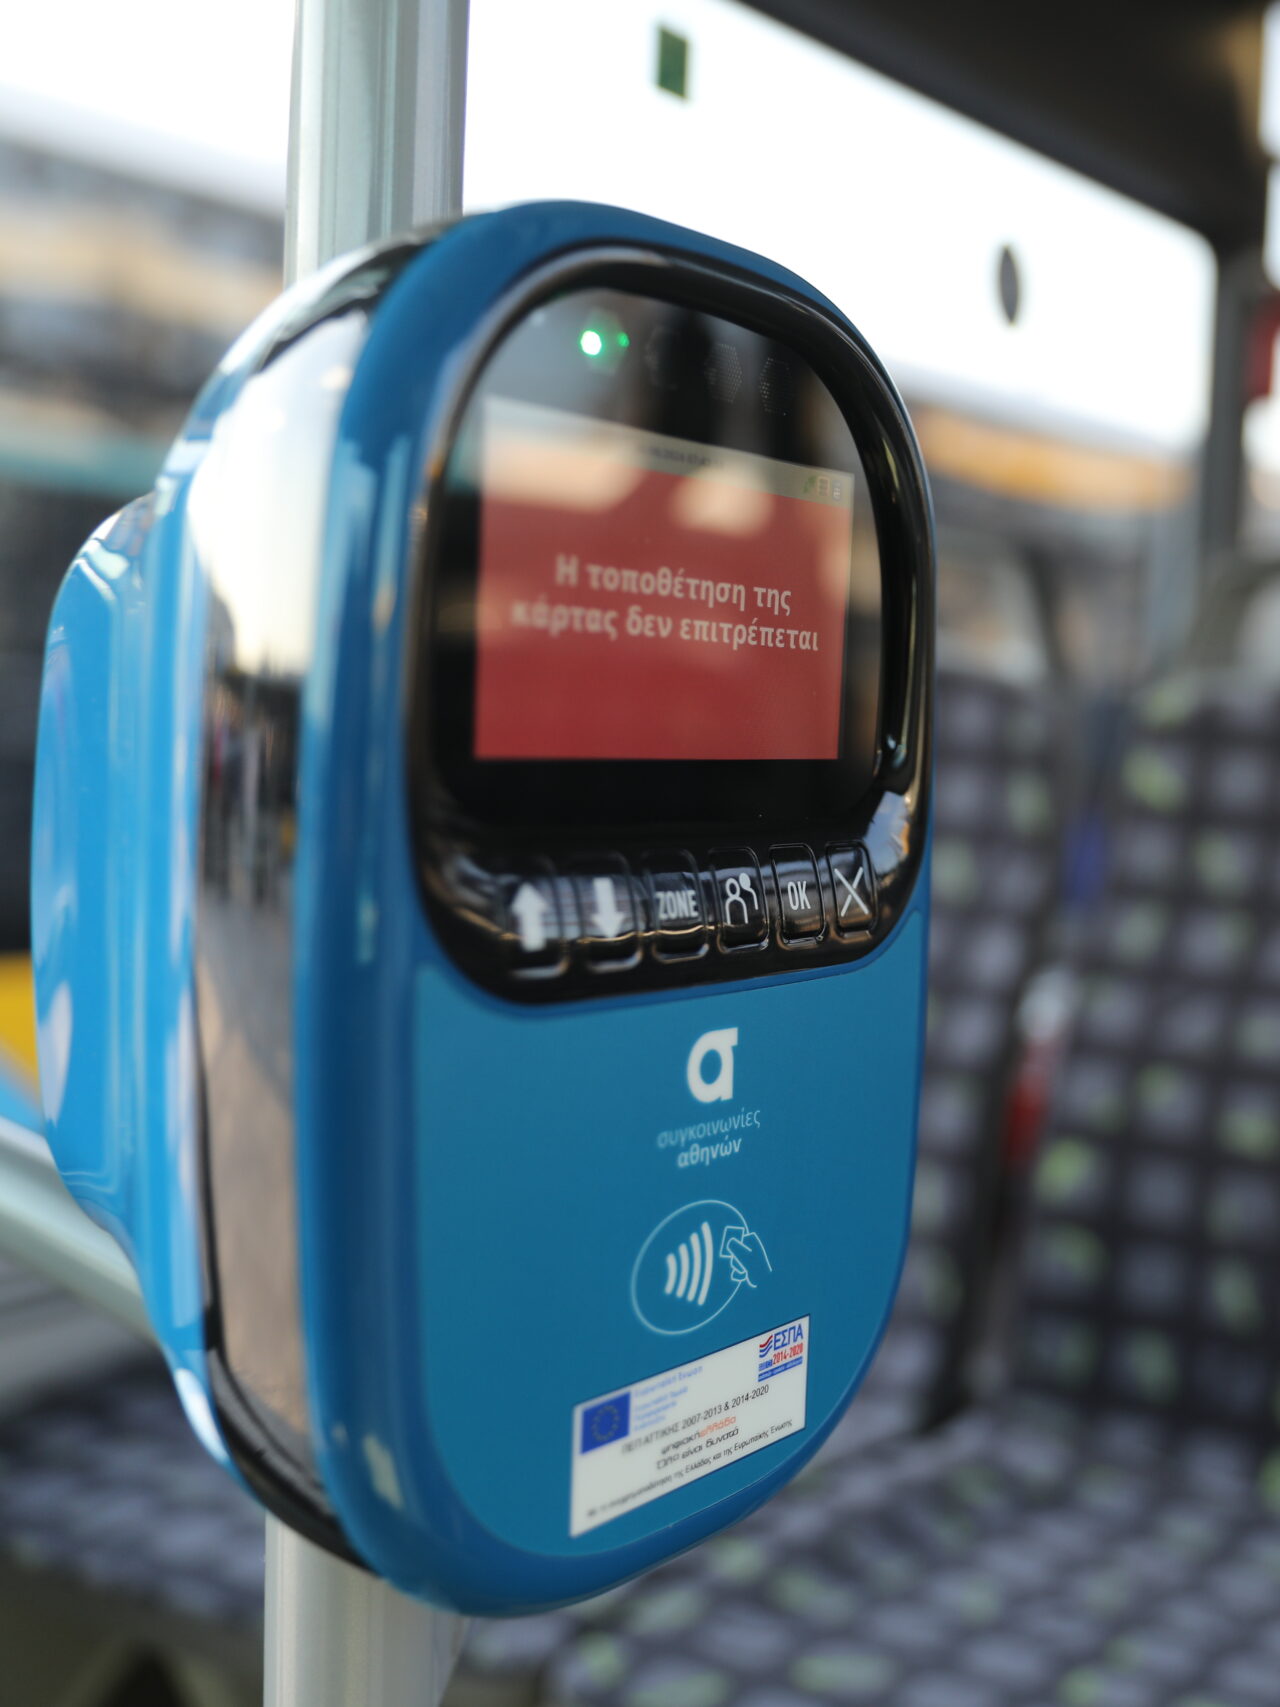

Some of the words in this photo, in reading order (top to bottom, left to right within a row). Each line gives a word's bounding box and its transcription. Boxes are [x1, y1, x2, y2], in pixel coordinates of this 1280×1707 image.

[555, 553, 579, 588] Η
[586, 563, 746, 611] τοποθέτηση
[753, 586, 792, 616] της
[510, 594, 618, 640] κάρτας
[626, 606, 674, 638] δεν
[679, 618, 818, 651] επιτρέπεται
[655, 889, 699, 919] ZONE
[787, 880, 811, 911] OK
[656, 1107, 761, 1149] συγκοινωνίες
[677, 1135, 742, 1168] αθηνών
[773, 1323, 803, 1350] ΕΣΠΑ
[772, 1343, 803, 1364] 2014-2020
[681, 1406, 722, 1430] 2007-2013
[723, 1401, 730, 1411] &
[732, 1384, 769, 1409] 2014-2020
